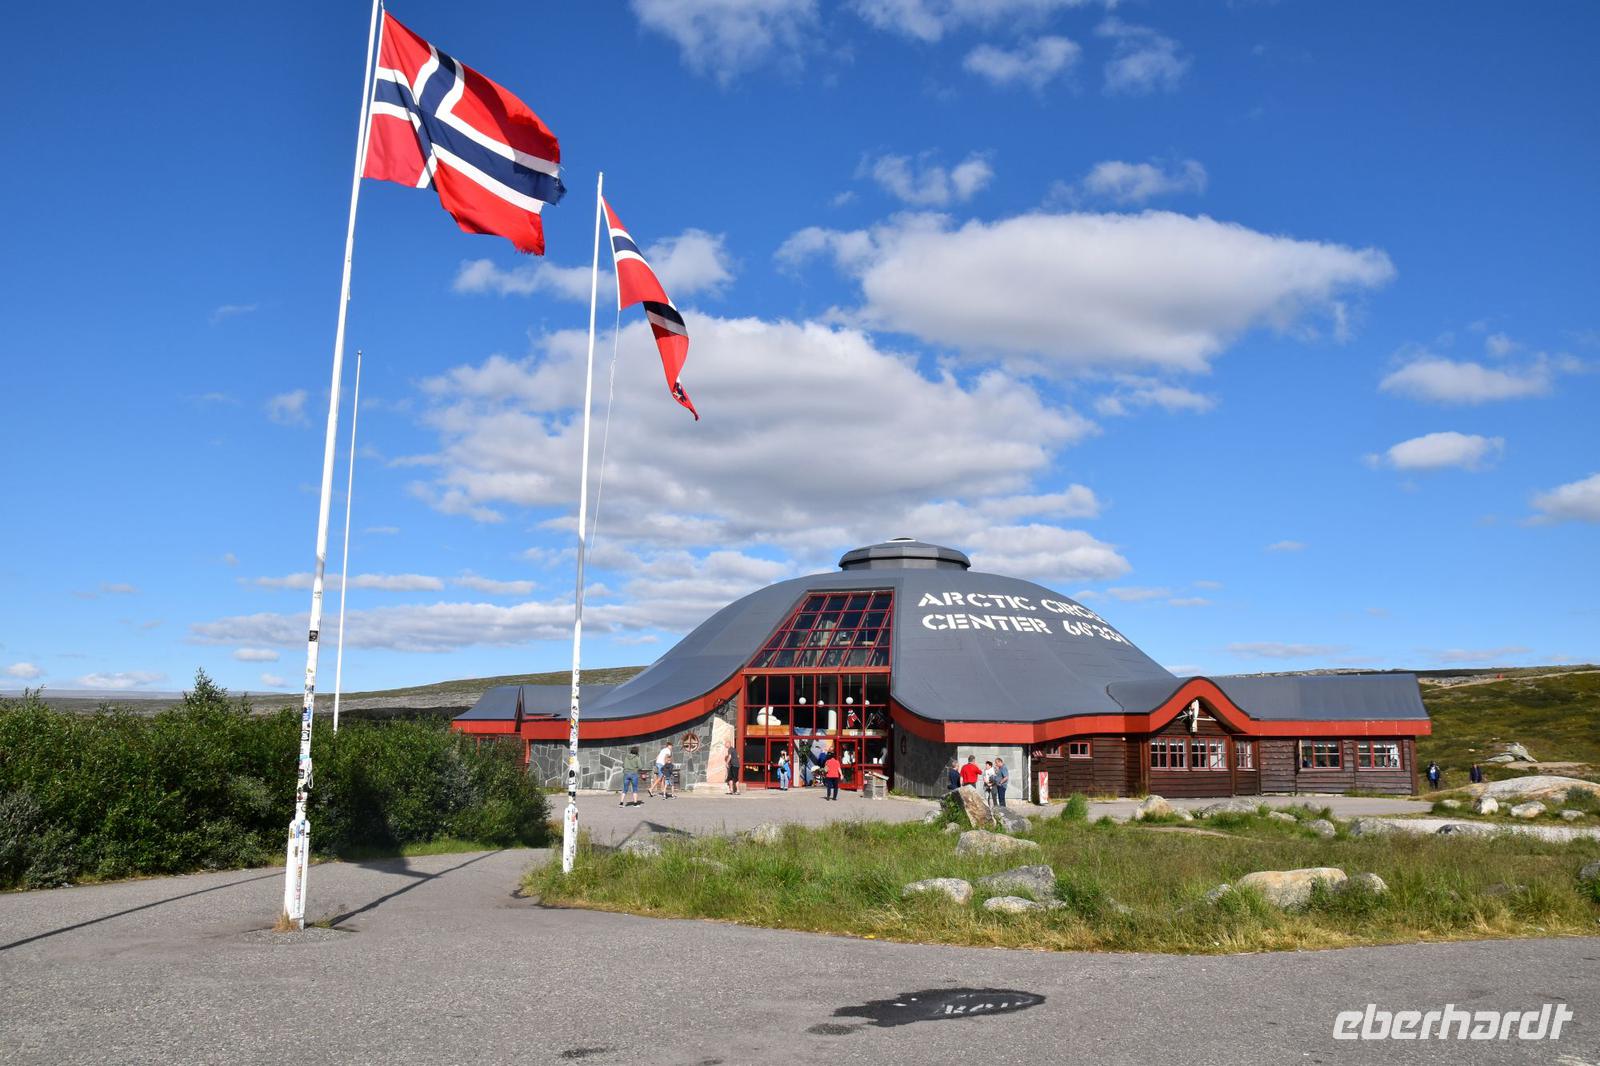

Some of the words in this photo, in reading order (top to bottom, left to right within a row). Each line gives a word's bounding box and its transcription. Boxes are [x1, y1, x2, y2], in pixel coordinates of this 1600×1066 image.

[918, 592, 1037, 611] ARCTIC
[1040, 598, 1108, 625] CIRC
[921, 613, 1052, 634] CENTER
